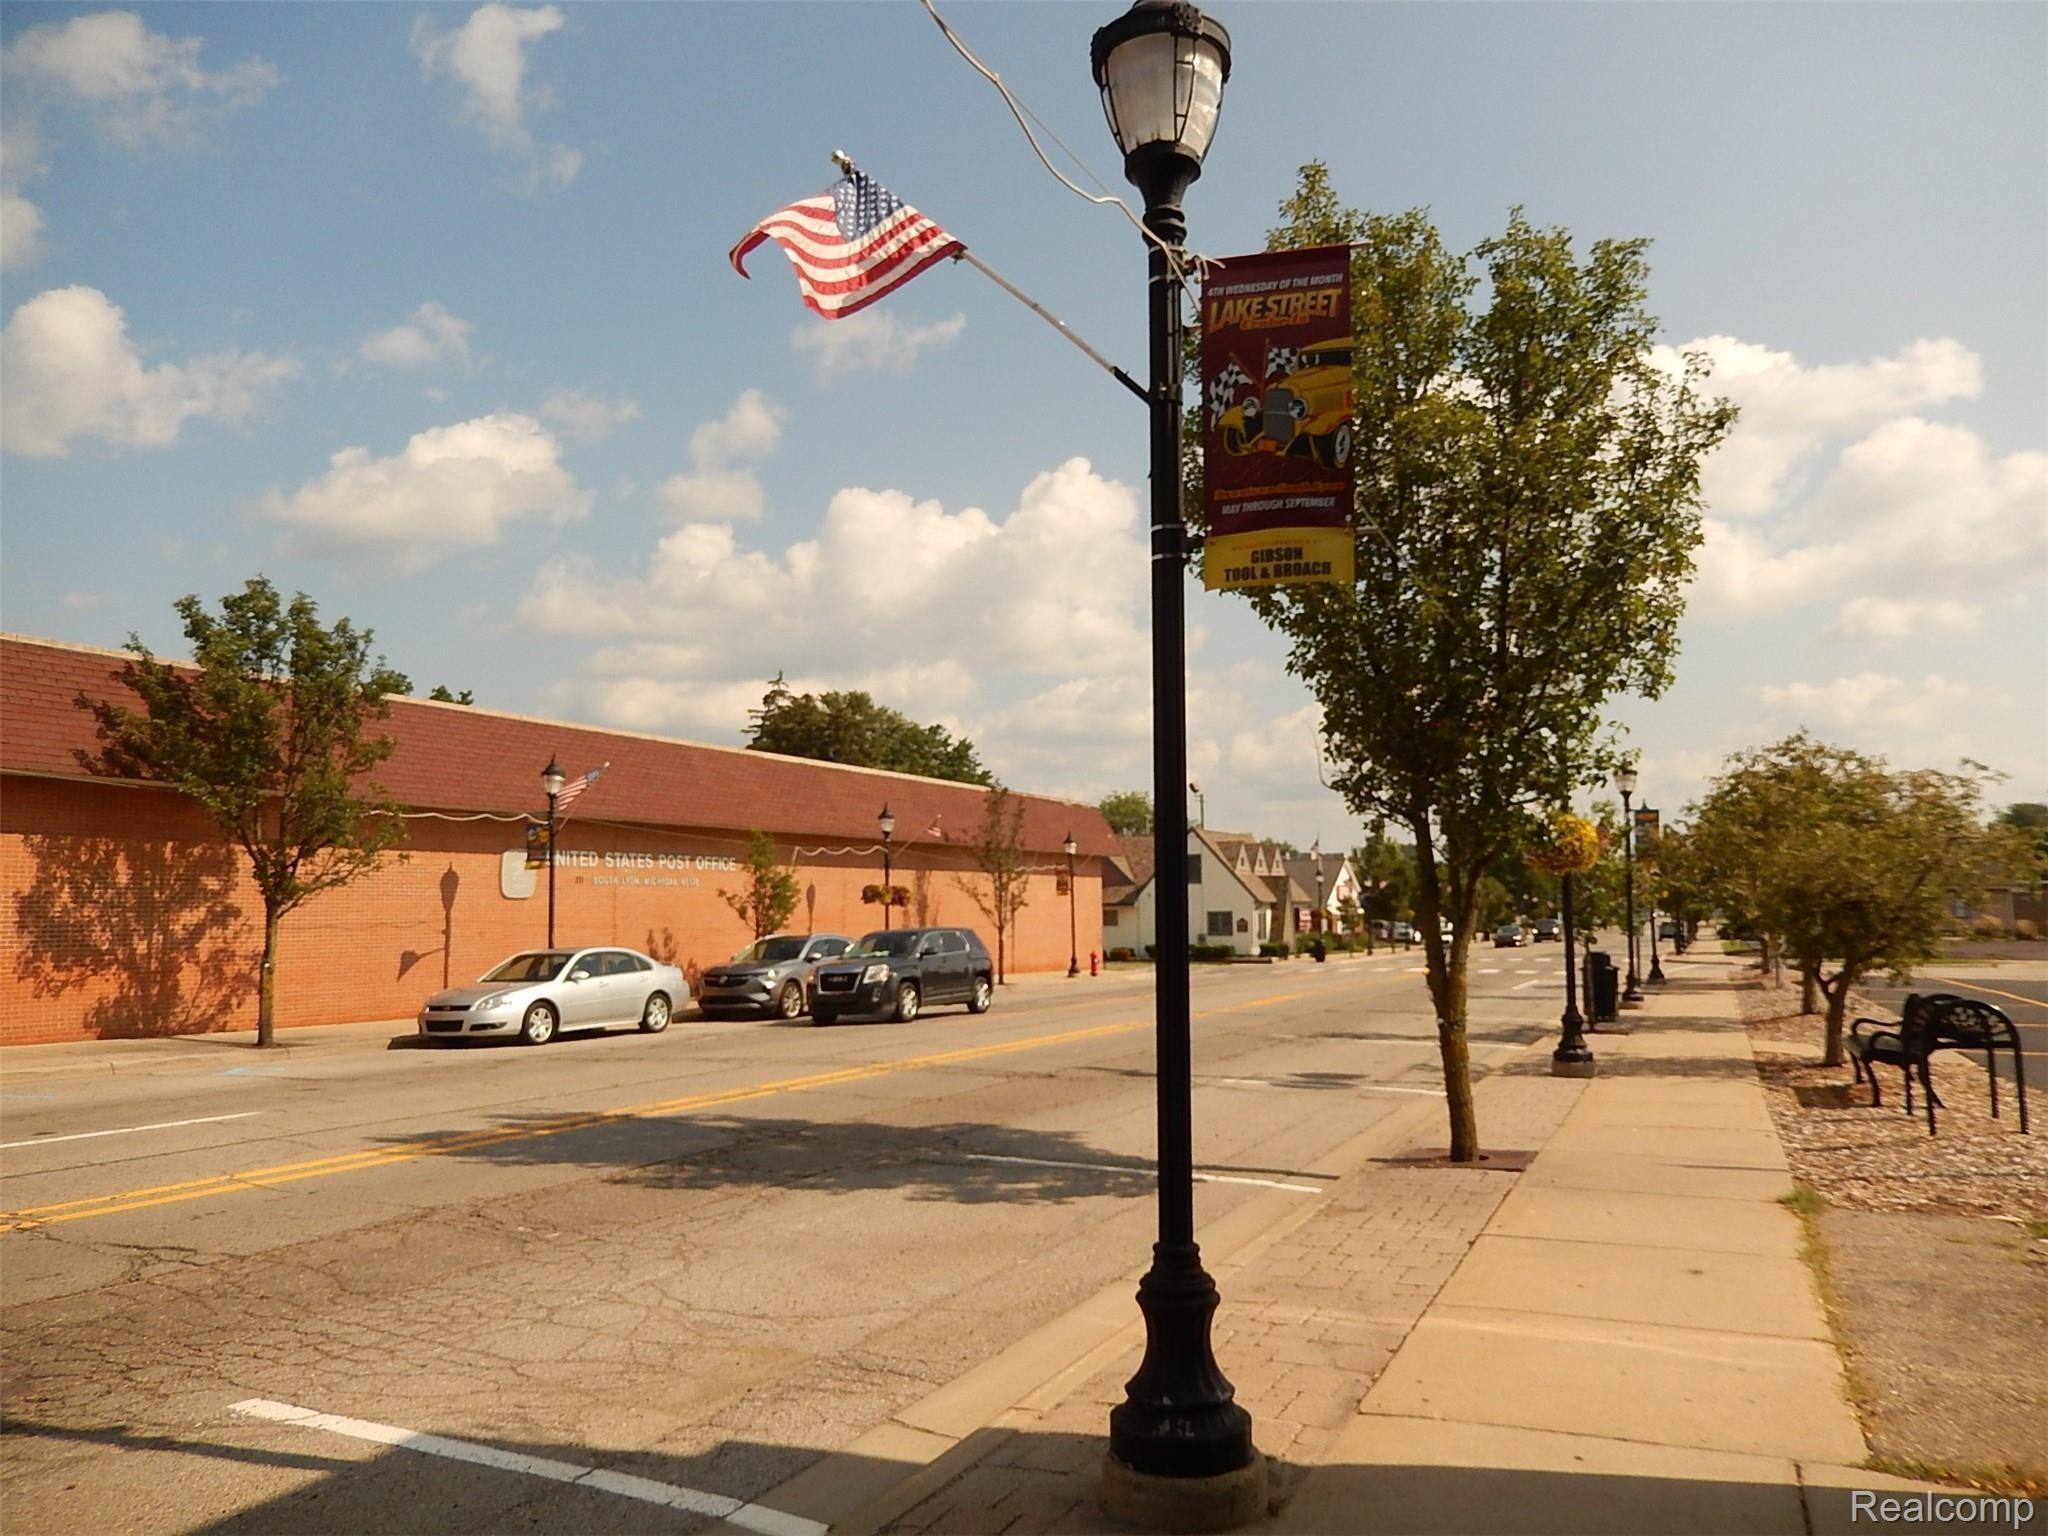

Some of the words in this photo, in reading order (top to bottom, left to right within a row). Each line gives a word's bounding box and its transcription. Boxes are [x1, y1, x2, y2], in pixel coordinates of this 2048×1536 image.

[1208, 287, 1224, 297] 4TH
[1225, 281, 1278, 296] WEDNESDAY
[1279, 279, 1292, 290] OF
[1292, 277, 1309, 287] THE
[1310, 273, 1344, 286] MONTH
[1222, 503, 1240, 515] MAY
[1242, 499, 1283, 512] THROUGH
[1285, 496, 1336, 509] SEPTEMBER
[1250, 546, 1303, 563] GIBSON
[1224, 566, 1257, 582] TOOL
[1260, 567, 1270, 579] &
[1273, 561, 1332, 579] BROACH
[604, 852, 654, 869] STATES
[659, 854, 691, 870] POST
[696, 856, 737, 872] OFFICE
[592, 875, 618, 885] SOUTH
